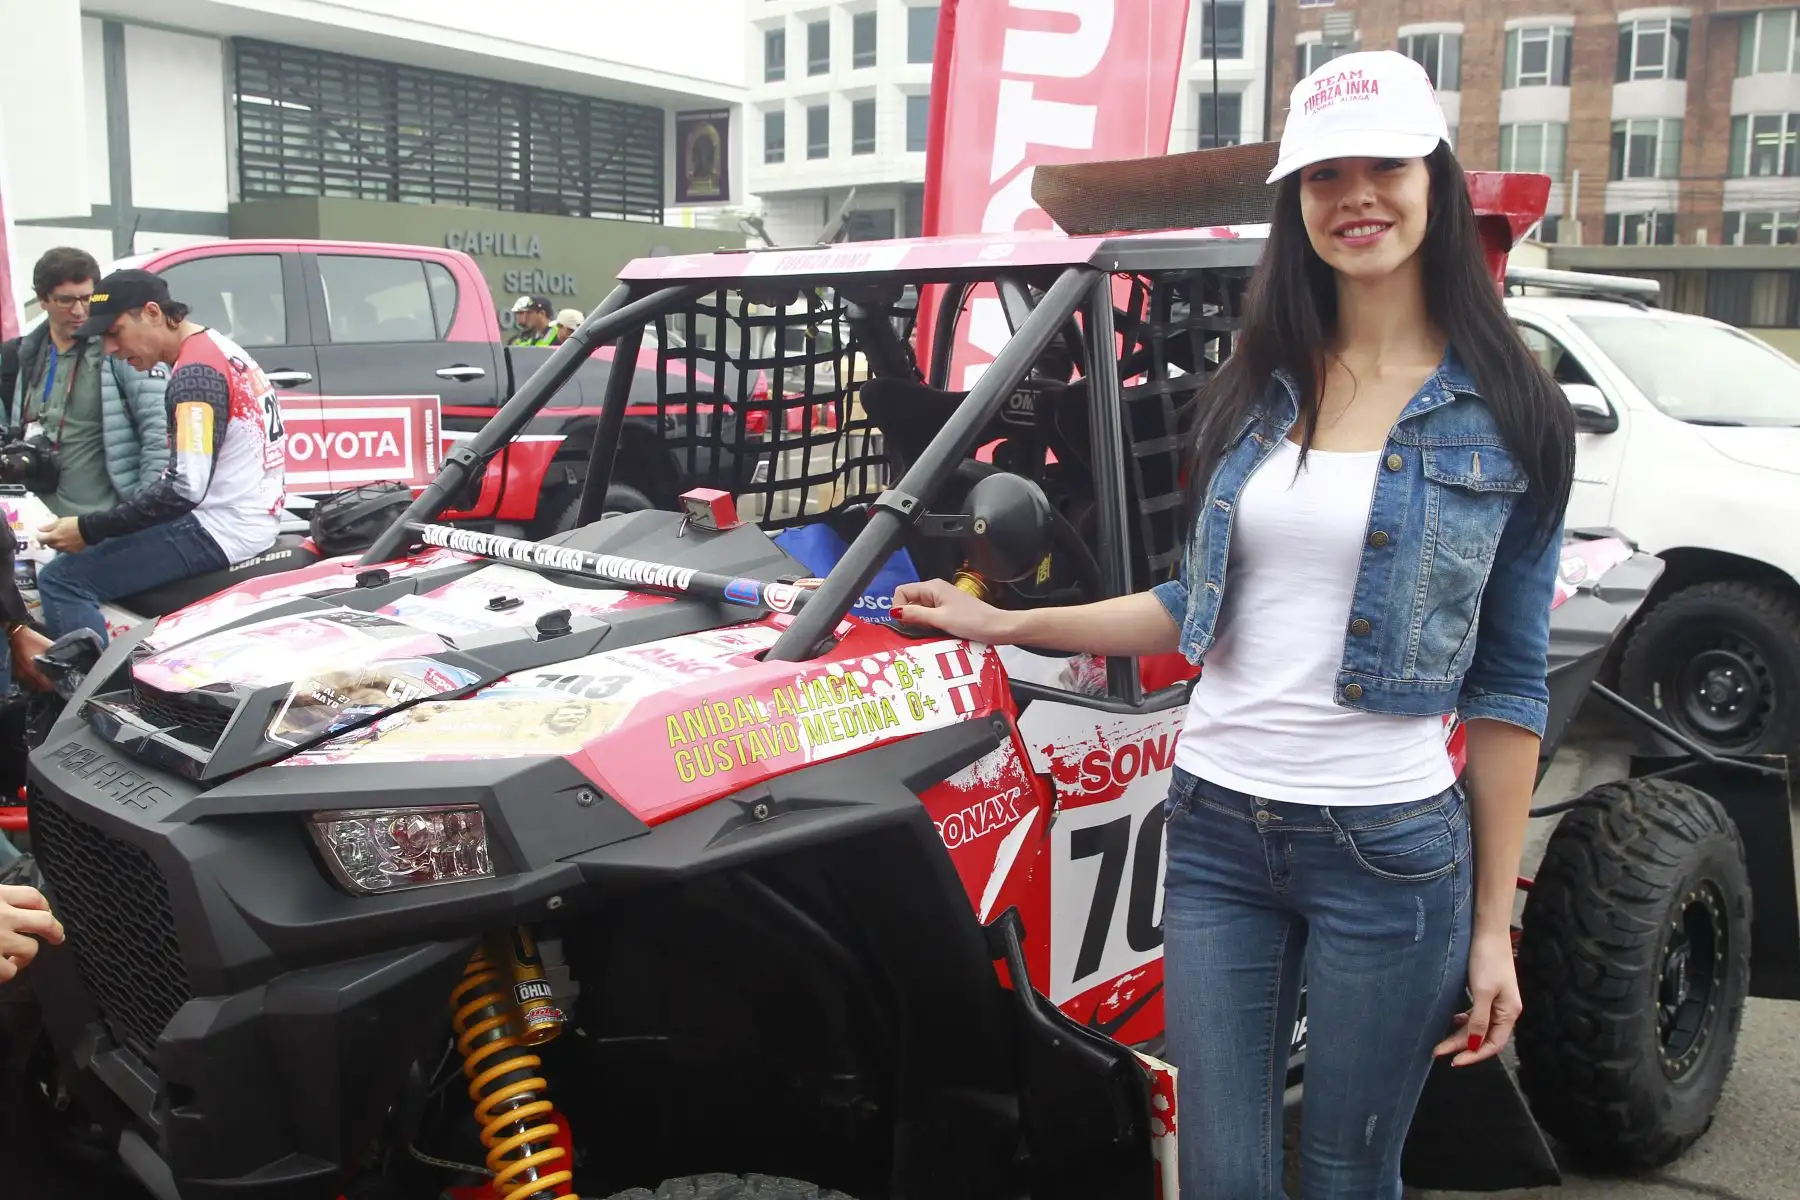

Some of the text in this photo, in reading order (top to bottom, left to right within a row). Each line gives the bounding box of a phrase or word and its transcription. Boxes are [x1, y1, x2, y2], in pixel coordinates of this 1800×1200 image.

[1303, 79, 1379, 116] FUERZA INKA
[1314, 69, 1364, 91] TEAM
[446, 230, 541, 260] CAPILLA
[505, 267, 578, 296] SEÑOR
[422, 523, 449, 548] SAN
[450, 528, 511, 559] AGUSTIN
[512, 539, 535, 563] DE
[311, 691, 340, 709] MAYO
[665, 659, 925, 748] ANÍBAL ALIAGA B+
[674, 722, 800, 783] GUSTAVO
[801, 697, 900, 747] MEDINA
[42, 742, 173, 810] POLARIS
